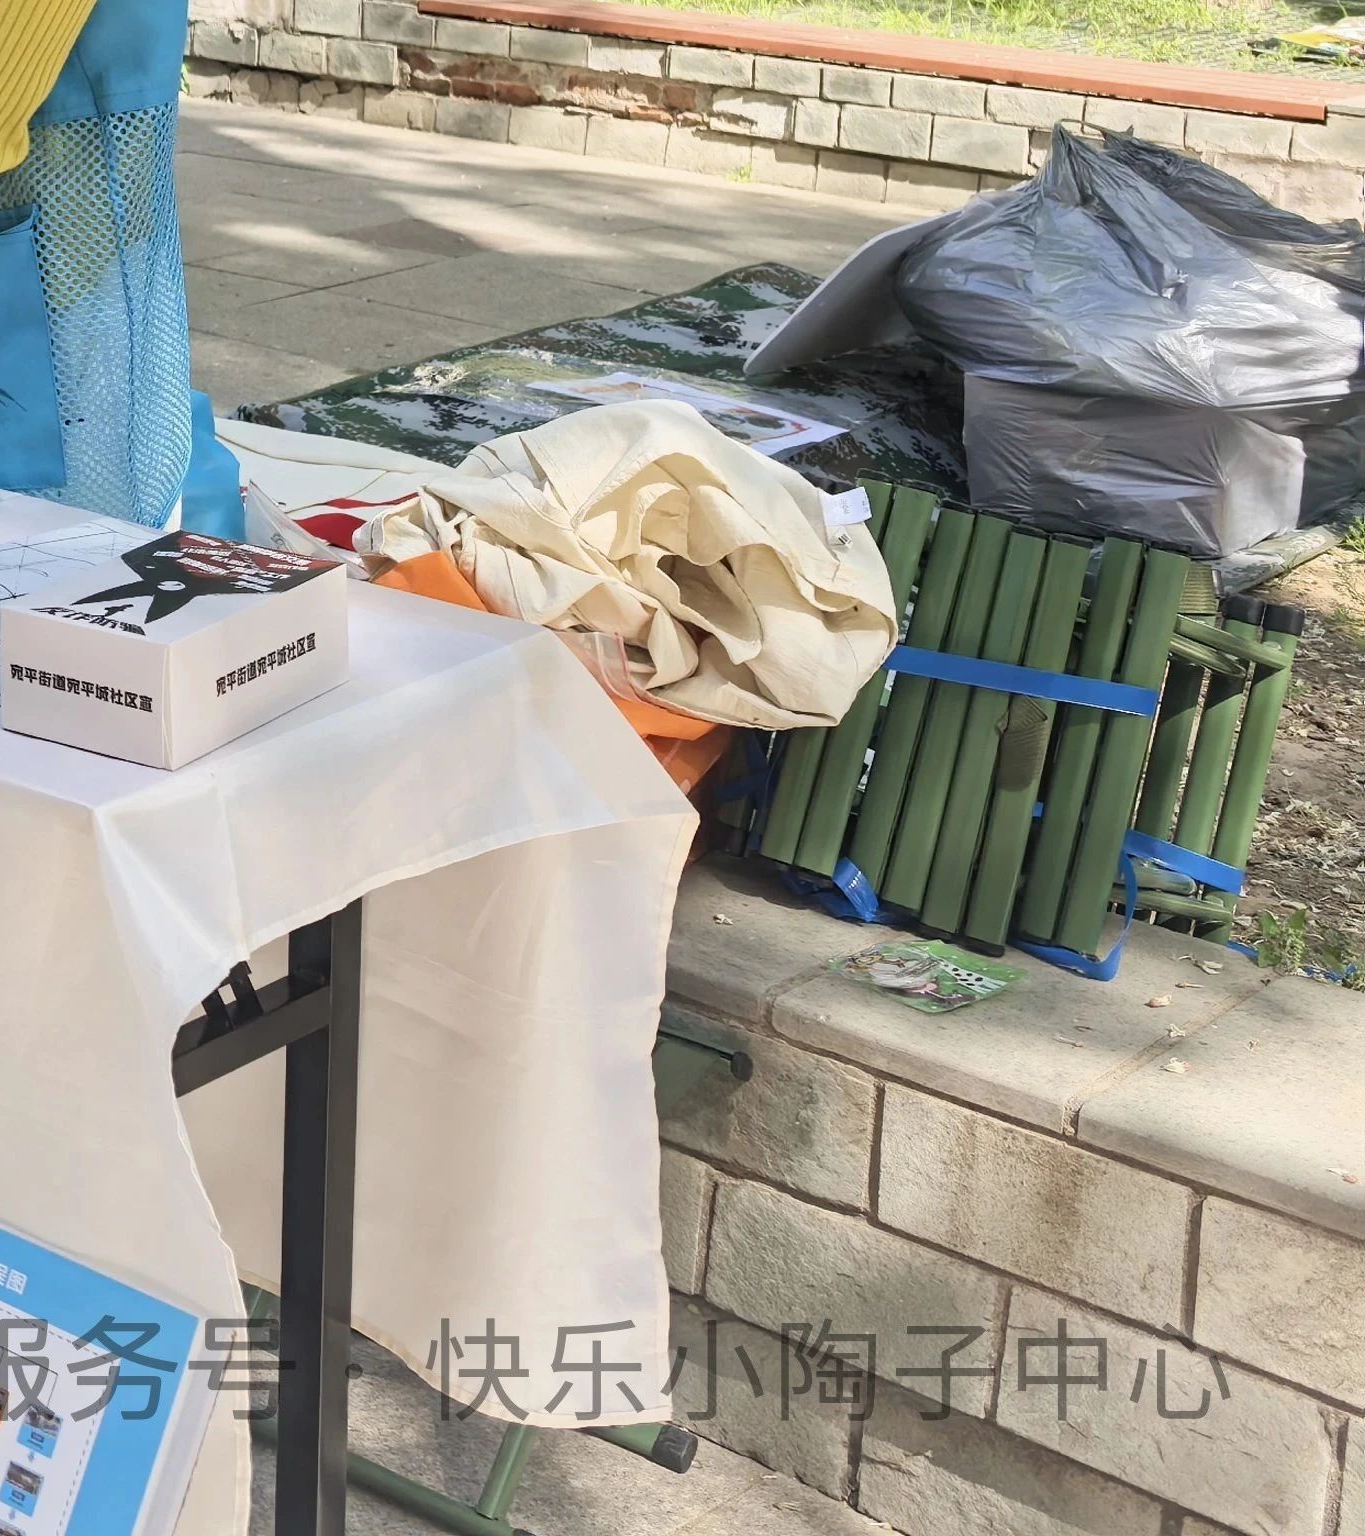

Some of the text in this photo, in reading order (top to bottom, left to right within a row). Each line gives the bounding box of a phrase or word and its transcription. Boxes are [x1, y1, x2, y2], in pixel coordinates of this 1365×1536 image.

[10, 663, 154, 714] 宛平街道宛平城社区宣
[215, 632, 317, 698] 宛平街道宛平城社区宣
